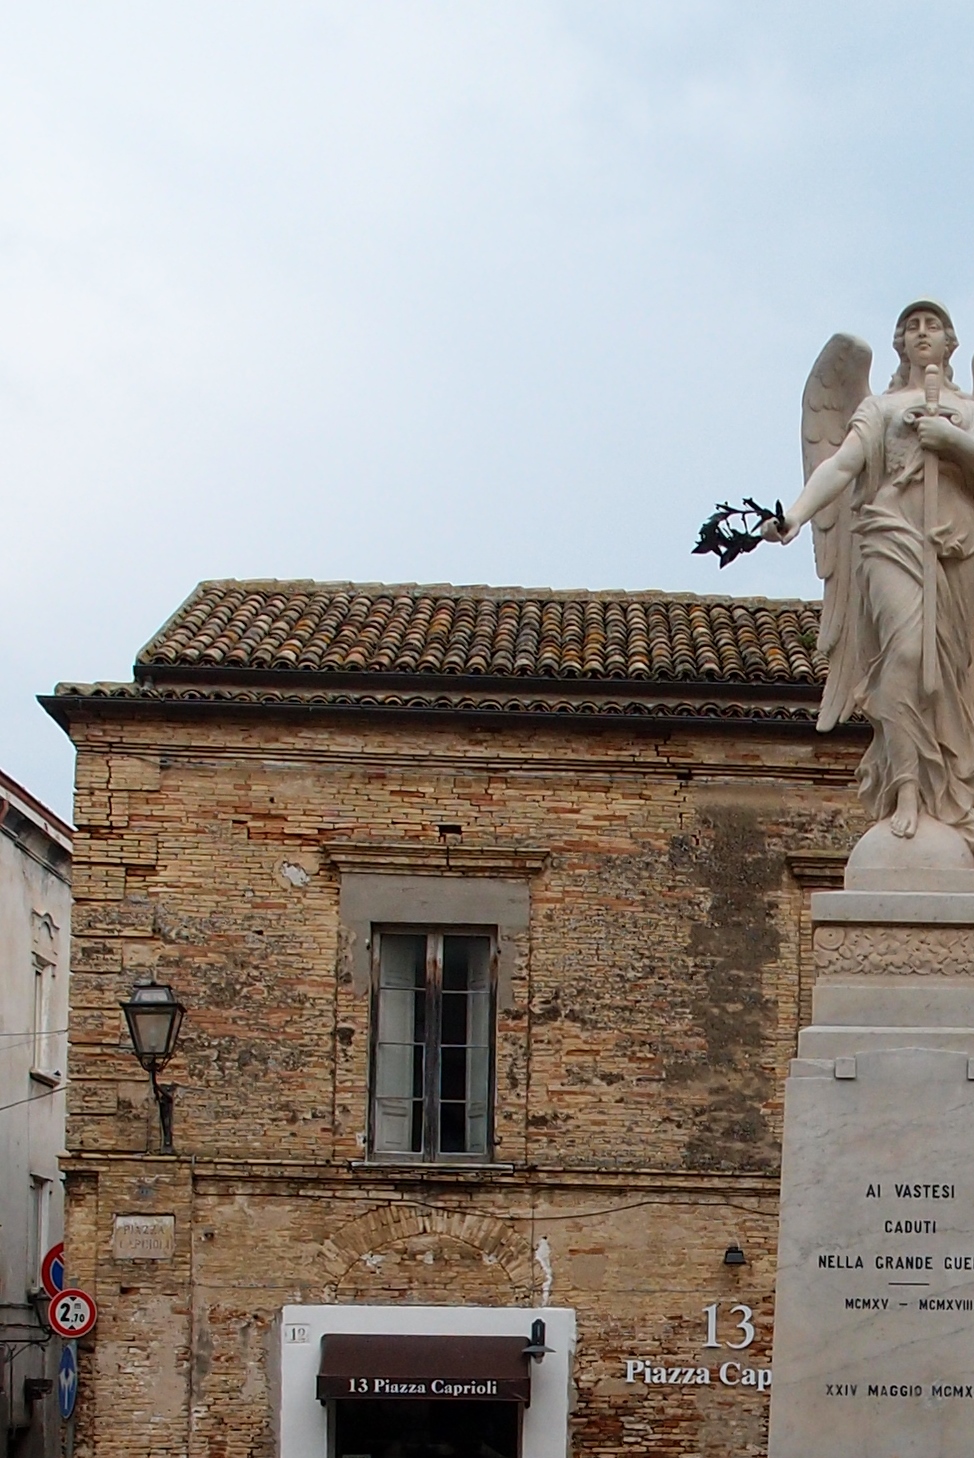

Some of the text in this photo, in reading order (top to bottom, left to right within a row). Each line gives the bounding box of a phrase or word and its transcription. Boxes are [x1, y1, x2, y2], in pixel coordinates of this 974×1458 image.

[866, 1184, 955, 1199] AI VASTESI
[884, 1220, 937, 1234] CADUTI
[818, 1255, 864, 1269] NELLA
[875, 1256, 934, 1270] GRANDE
[845, 1298, 889, 1311] MCMXV
[918, 1298, 974, 1311] MCMXVIII
[701, 1303, 756, 1350] 13
[624, 1359, 772, 1392] Piazza Cap
[348, 1377, 497, 1397] 13 Piazza Caprioli
[825, 1384, 857, 1397] XXIV
[868, 1384, 923, 1397] MAGGIO
